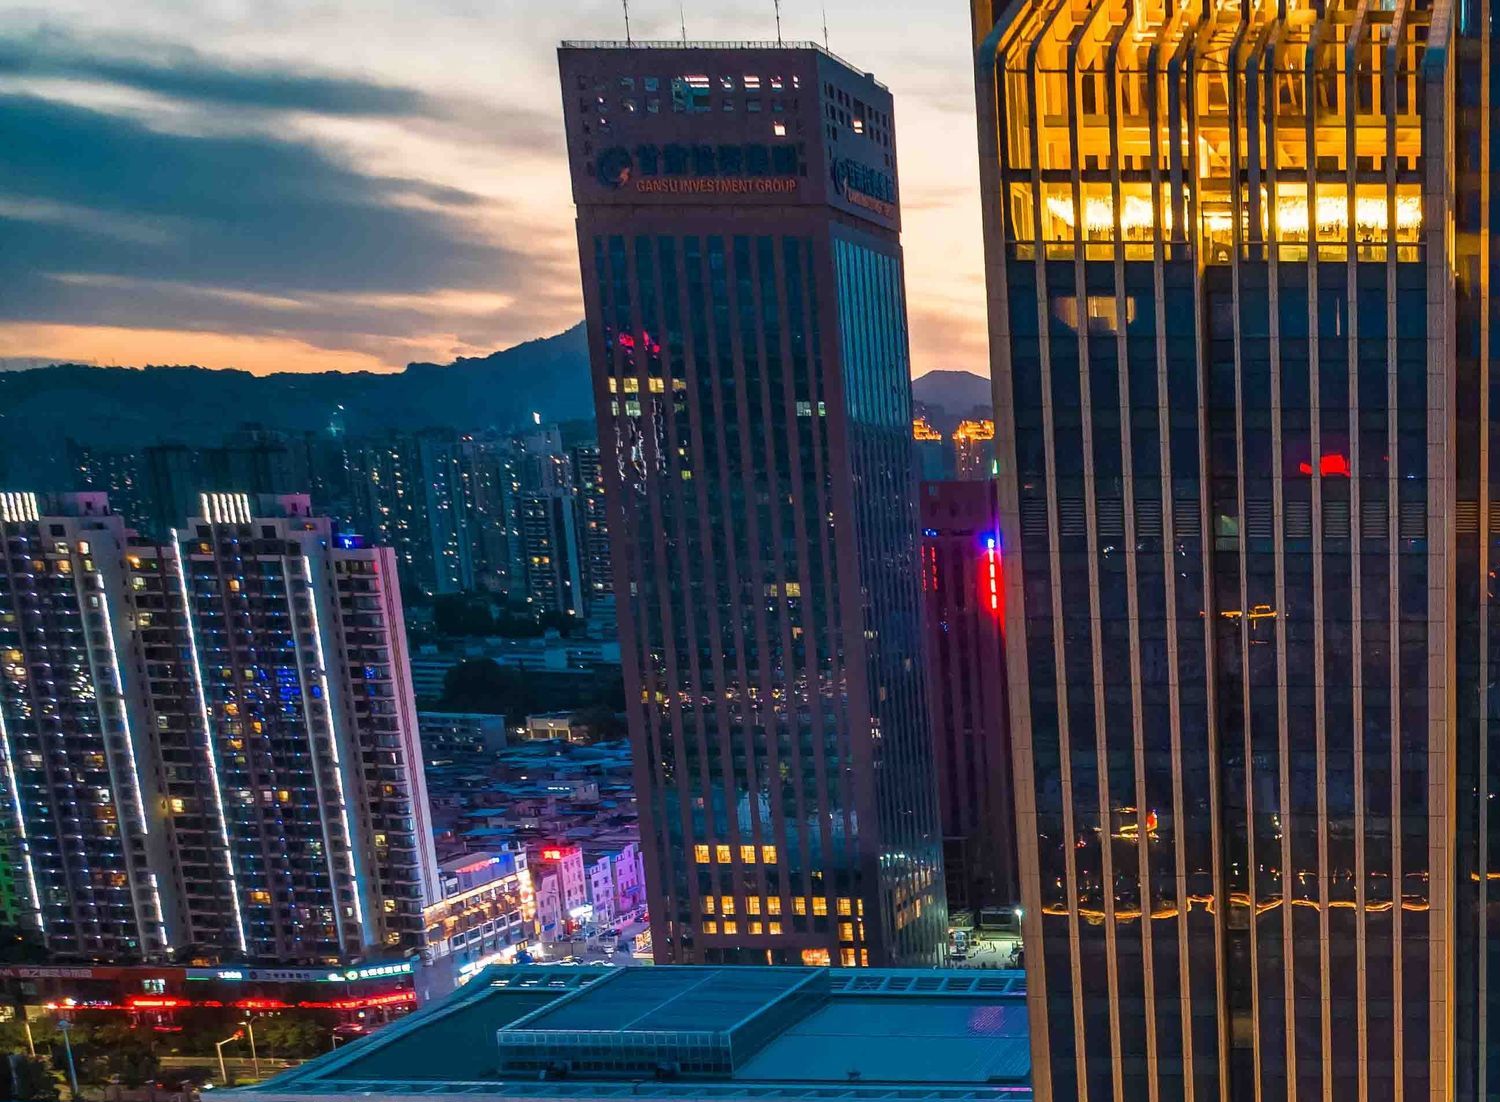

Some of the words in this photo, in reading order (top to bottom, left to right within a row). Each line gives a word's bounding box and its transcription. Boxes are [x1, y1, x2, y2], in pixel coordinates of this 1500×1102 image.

[636, 179, 678, 193] GANSU
[680, 179, 753, 193] INVESTMENT
[756, 179, 797, 193] GROUP
